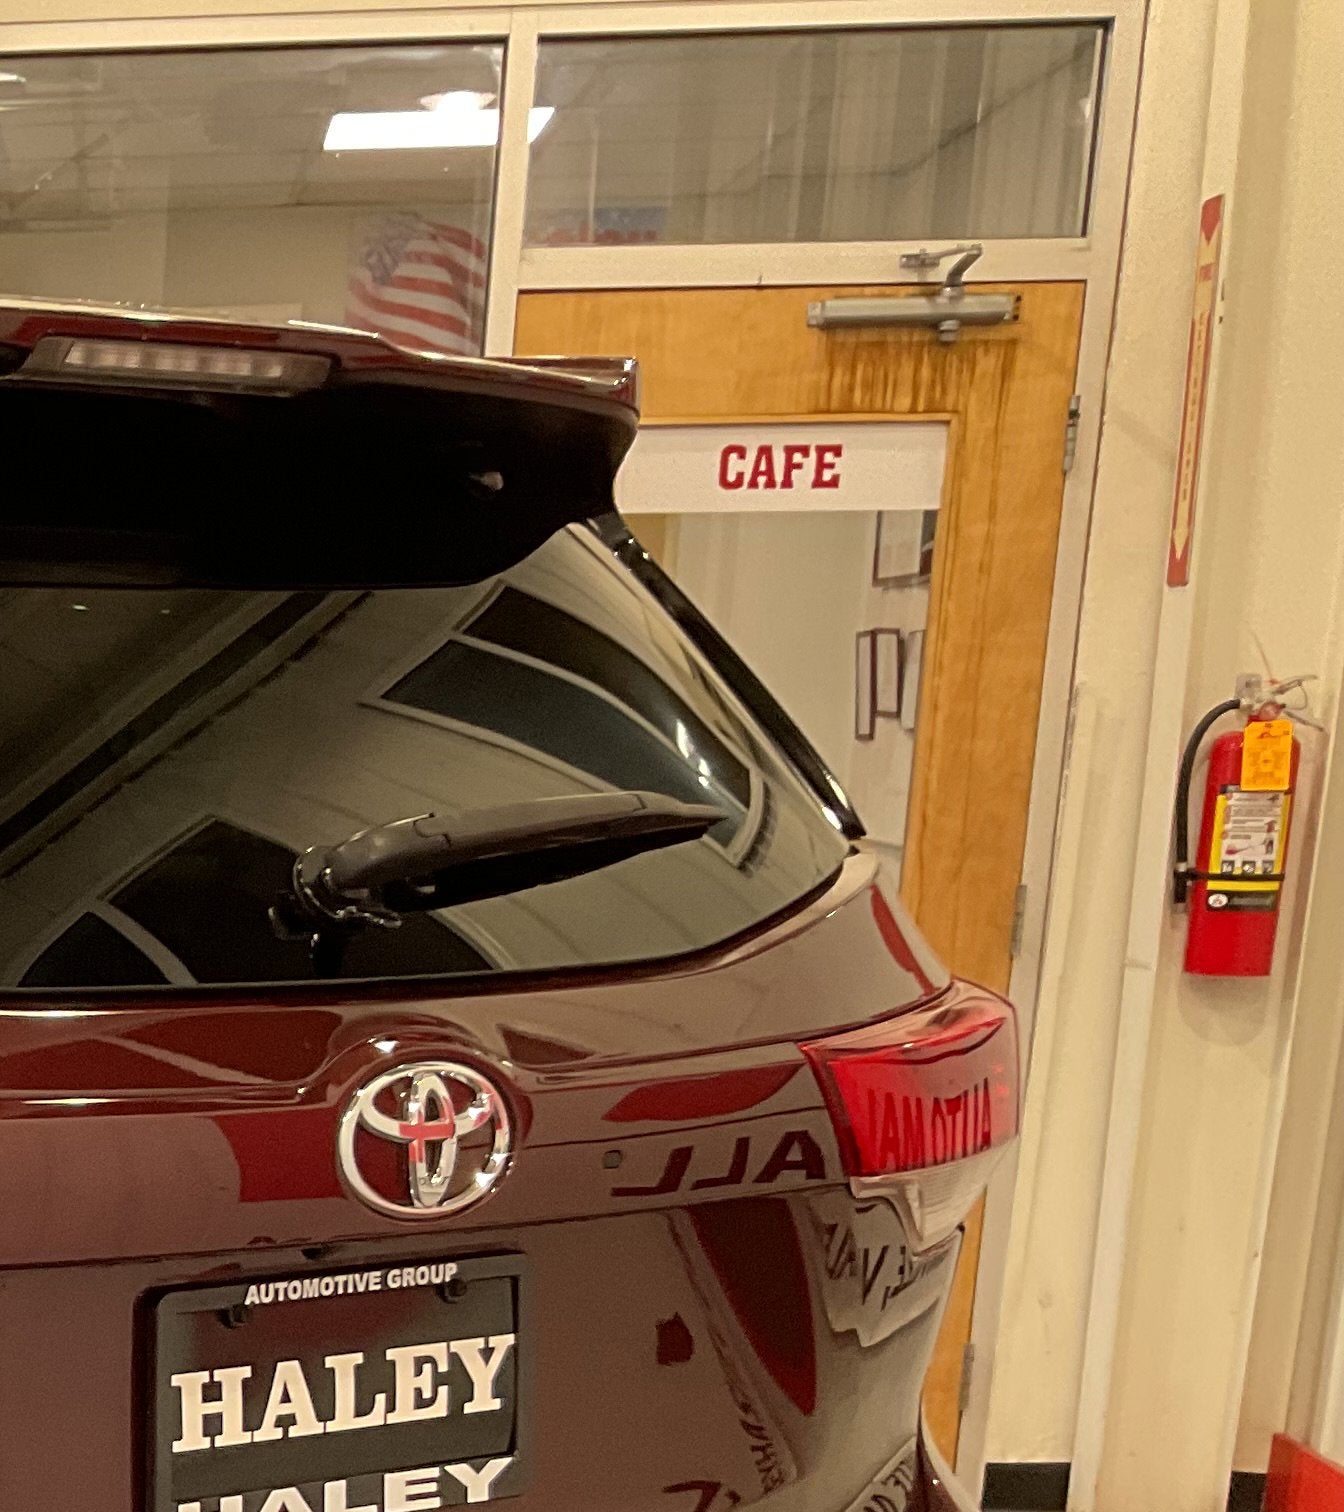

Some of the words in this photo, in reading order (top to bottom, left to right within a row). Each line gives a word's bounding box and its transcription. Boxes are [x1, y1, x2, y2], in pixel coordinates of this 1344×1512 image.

[719, 443, 843, 490] CAFE
[244, 1271, 382, 1305] AUTOMOTIVE
[386, 1263, 458, 1290] GROUP
[170, 1333, 515, 1454] HALEY
